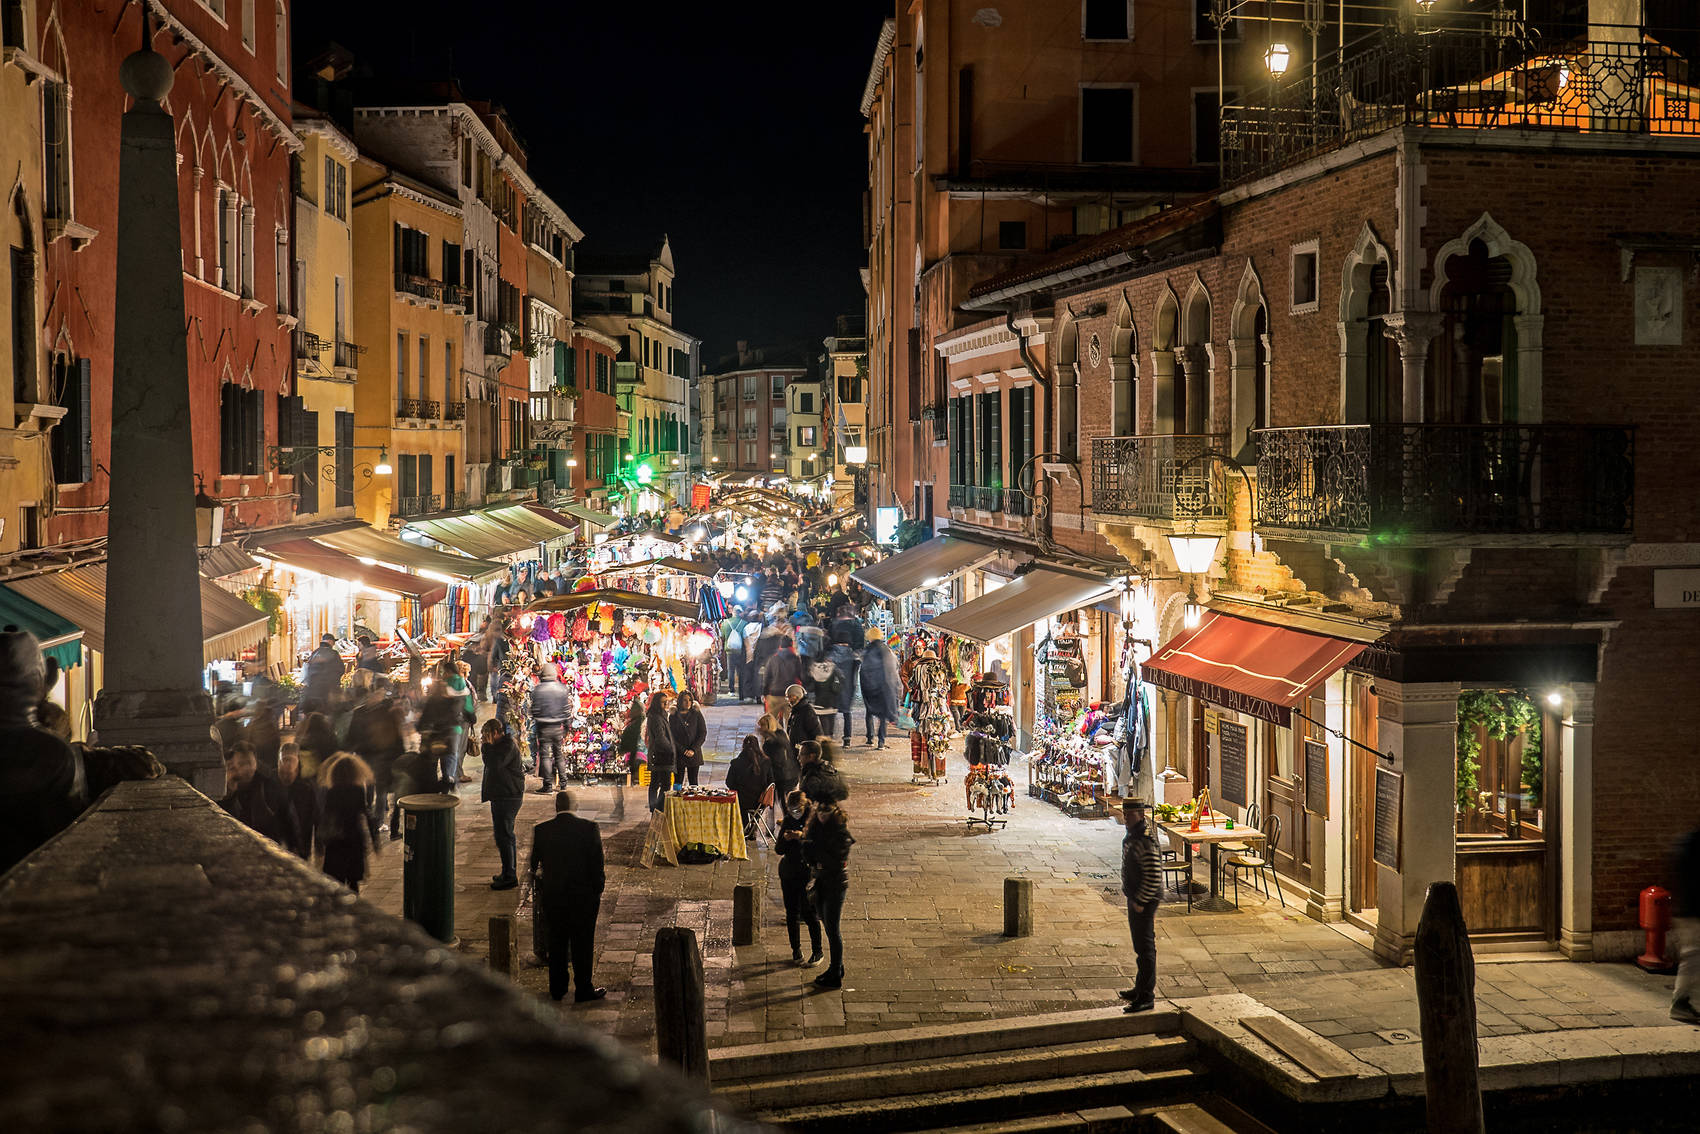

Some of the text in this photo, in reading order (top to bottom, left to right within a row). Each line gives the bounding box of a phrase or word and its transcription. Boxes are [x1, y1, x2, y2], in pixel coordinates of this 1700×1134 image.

[1148, 667, 1194, 696] TRATTORIA
[1200, 683, 1222, 704] ALLA
[1228, 691, 1281, 724] PALAZZINA
